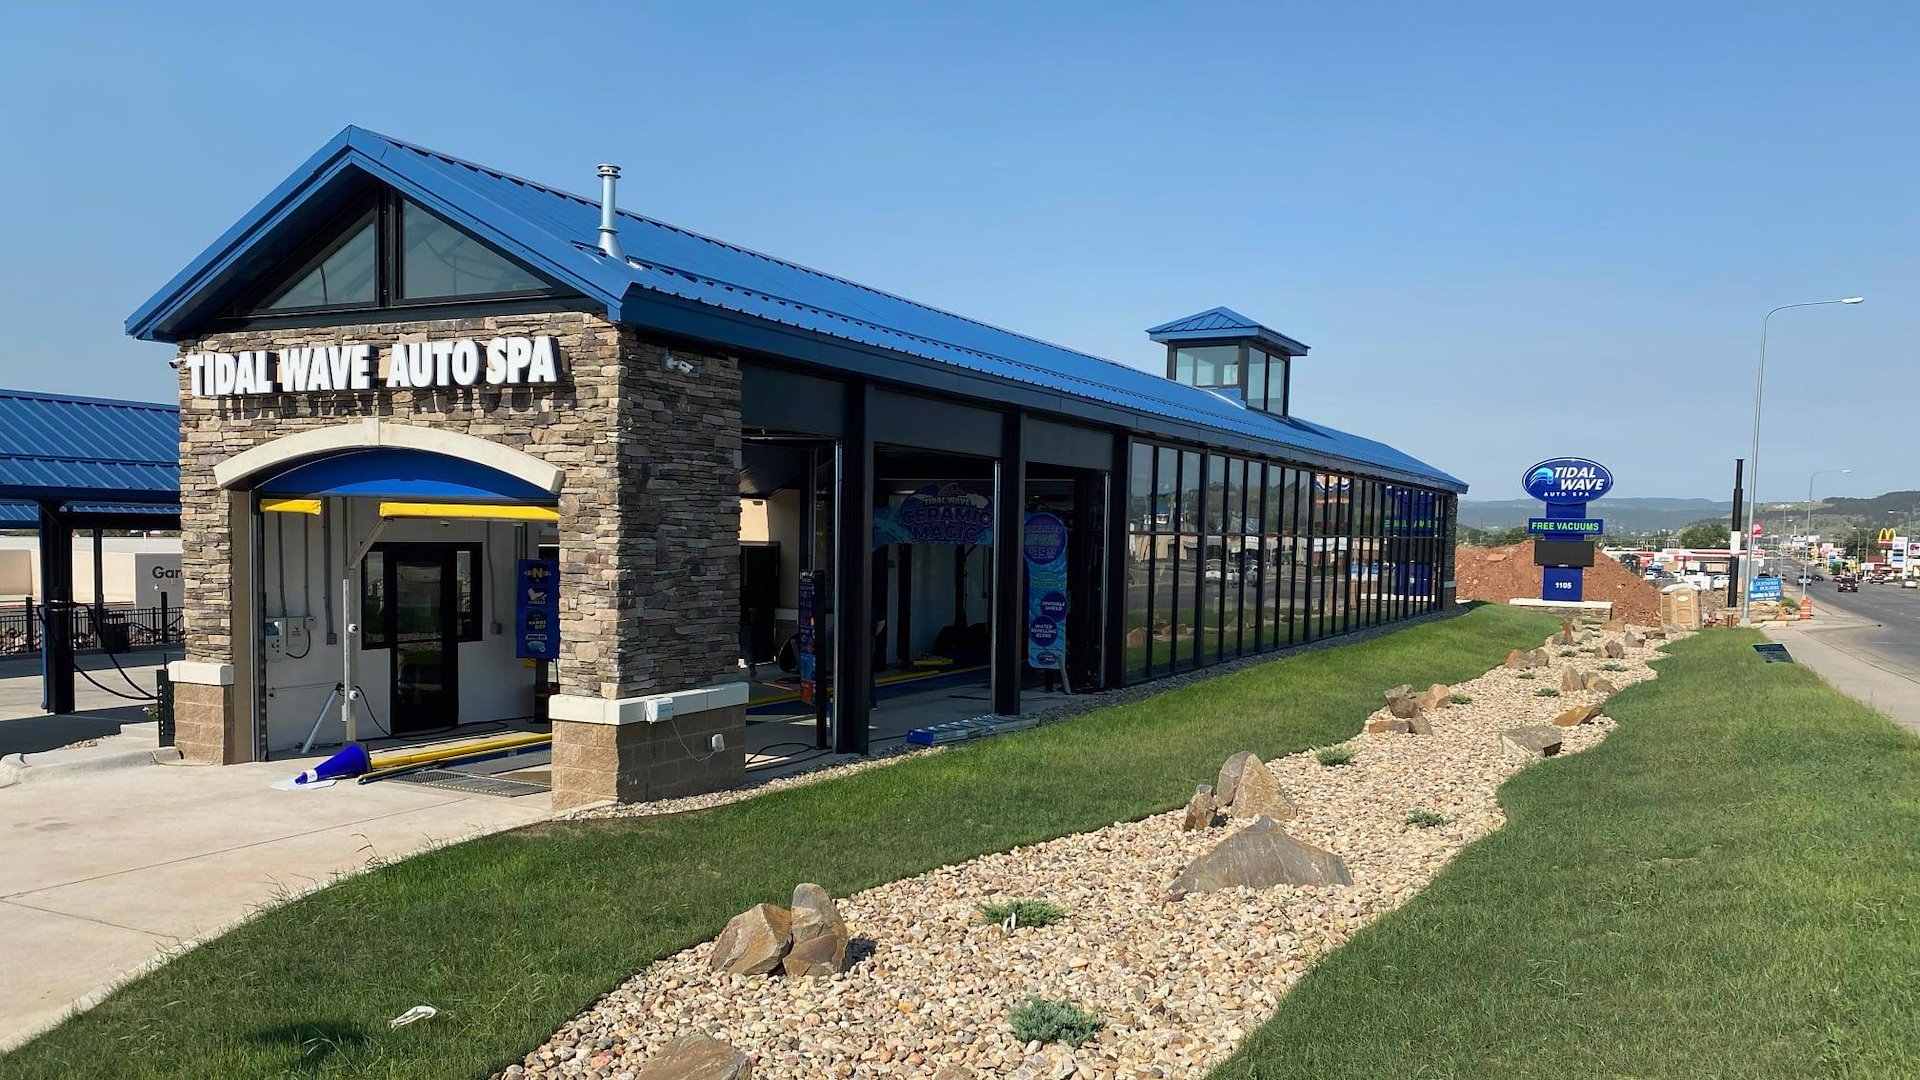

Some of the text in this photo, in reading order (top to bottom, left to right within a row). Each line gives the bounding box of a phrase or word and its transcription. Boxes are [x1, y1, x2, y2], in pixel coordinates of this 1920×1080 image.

[186, 335, 558, 396] TIDAL WAVE AUTO SPA
[1554, 467, 1596, 478] TIDAL
[1560, 479, 1604, 490] WAVE
[1531, 522, 1600, 531] FREE VACUUMS
[912, 524, 978, 543] MAGIC
[152, 566, 182, 579] Gar
